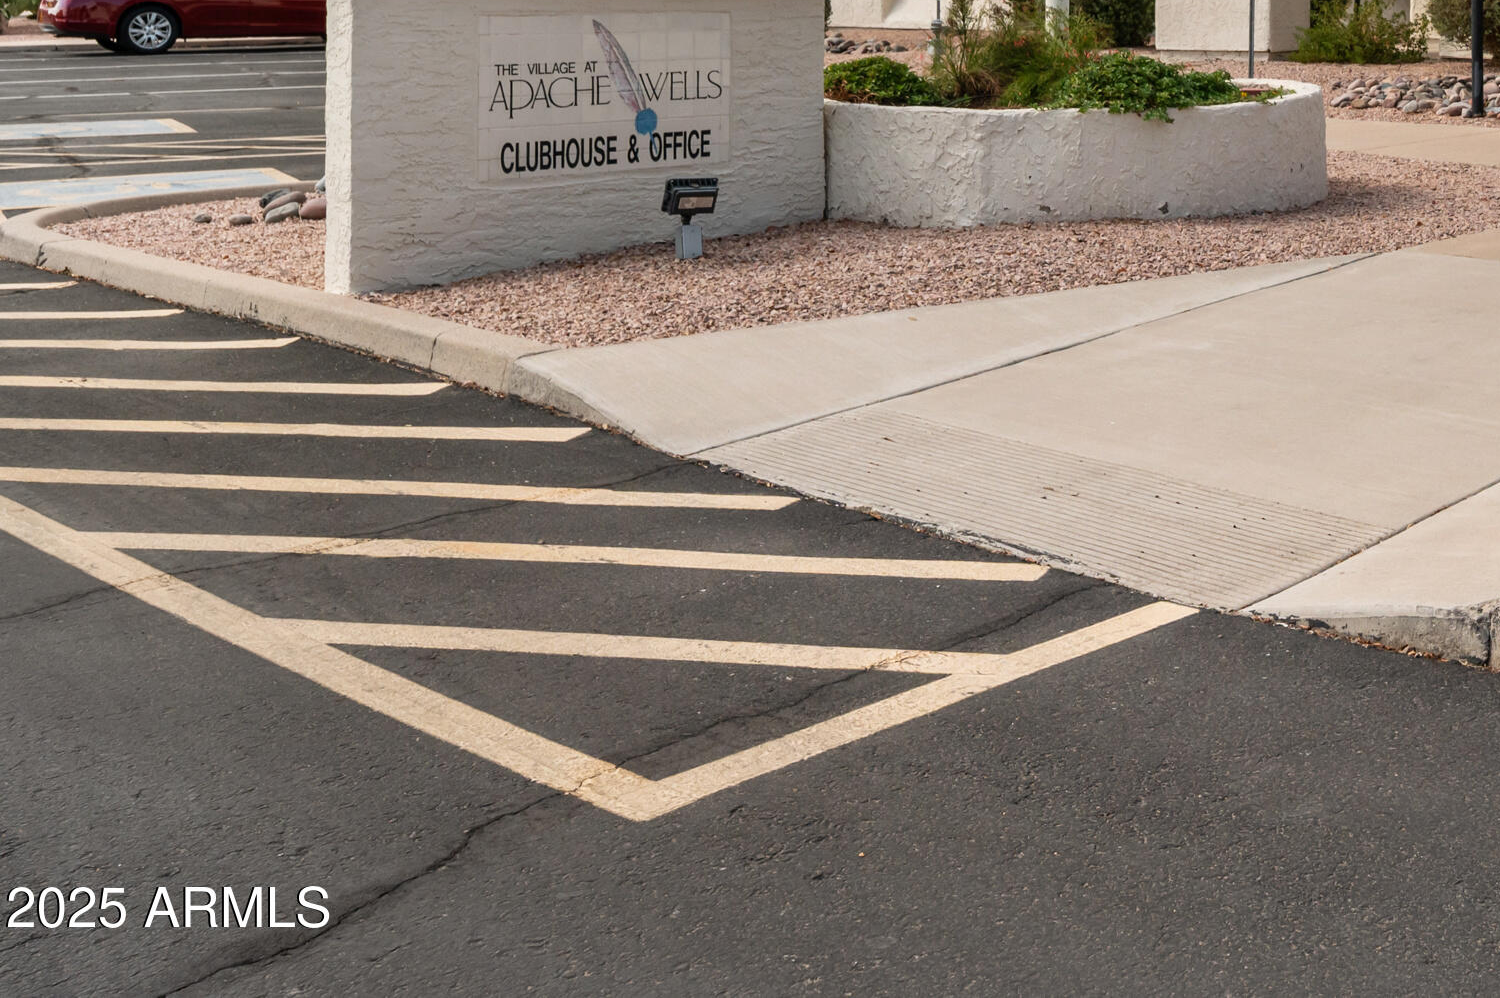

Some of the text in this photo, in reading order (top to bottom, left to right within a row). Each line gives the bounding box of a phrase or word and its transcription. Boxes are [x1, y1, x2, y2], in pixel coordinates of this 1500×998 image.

[495, 60, 598, 77] THE VILLAGE AT
[488, 70, 723, 120] APACHE WELLS
[500, 129, 712, 174] CLUBHOUSE & OFFICE
